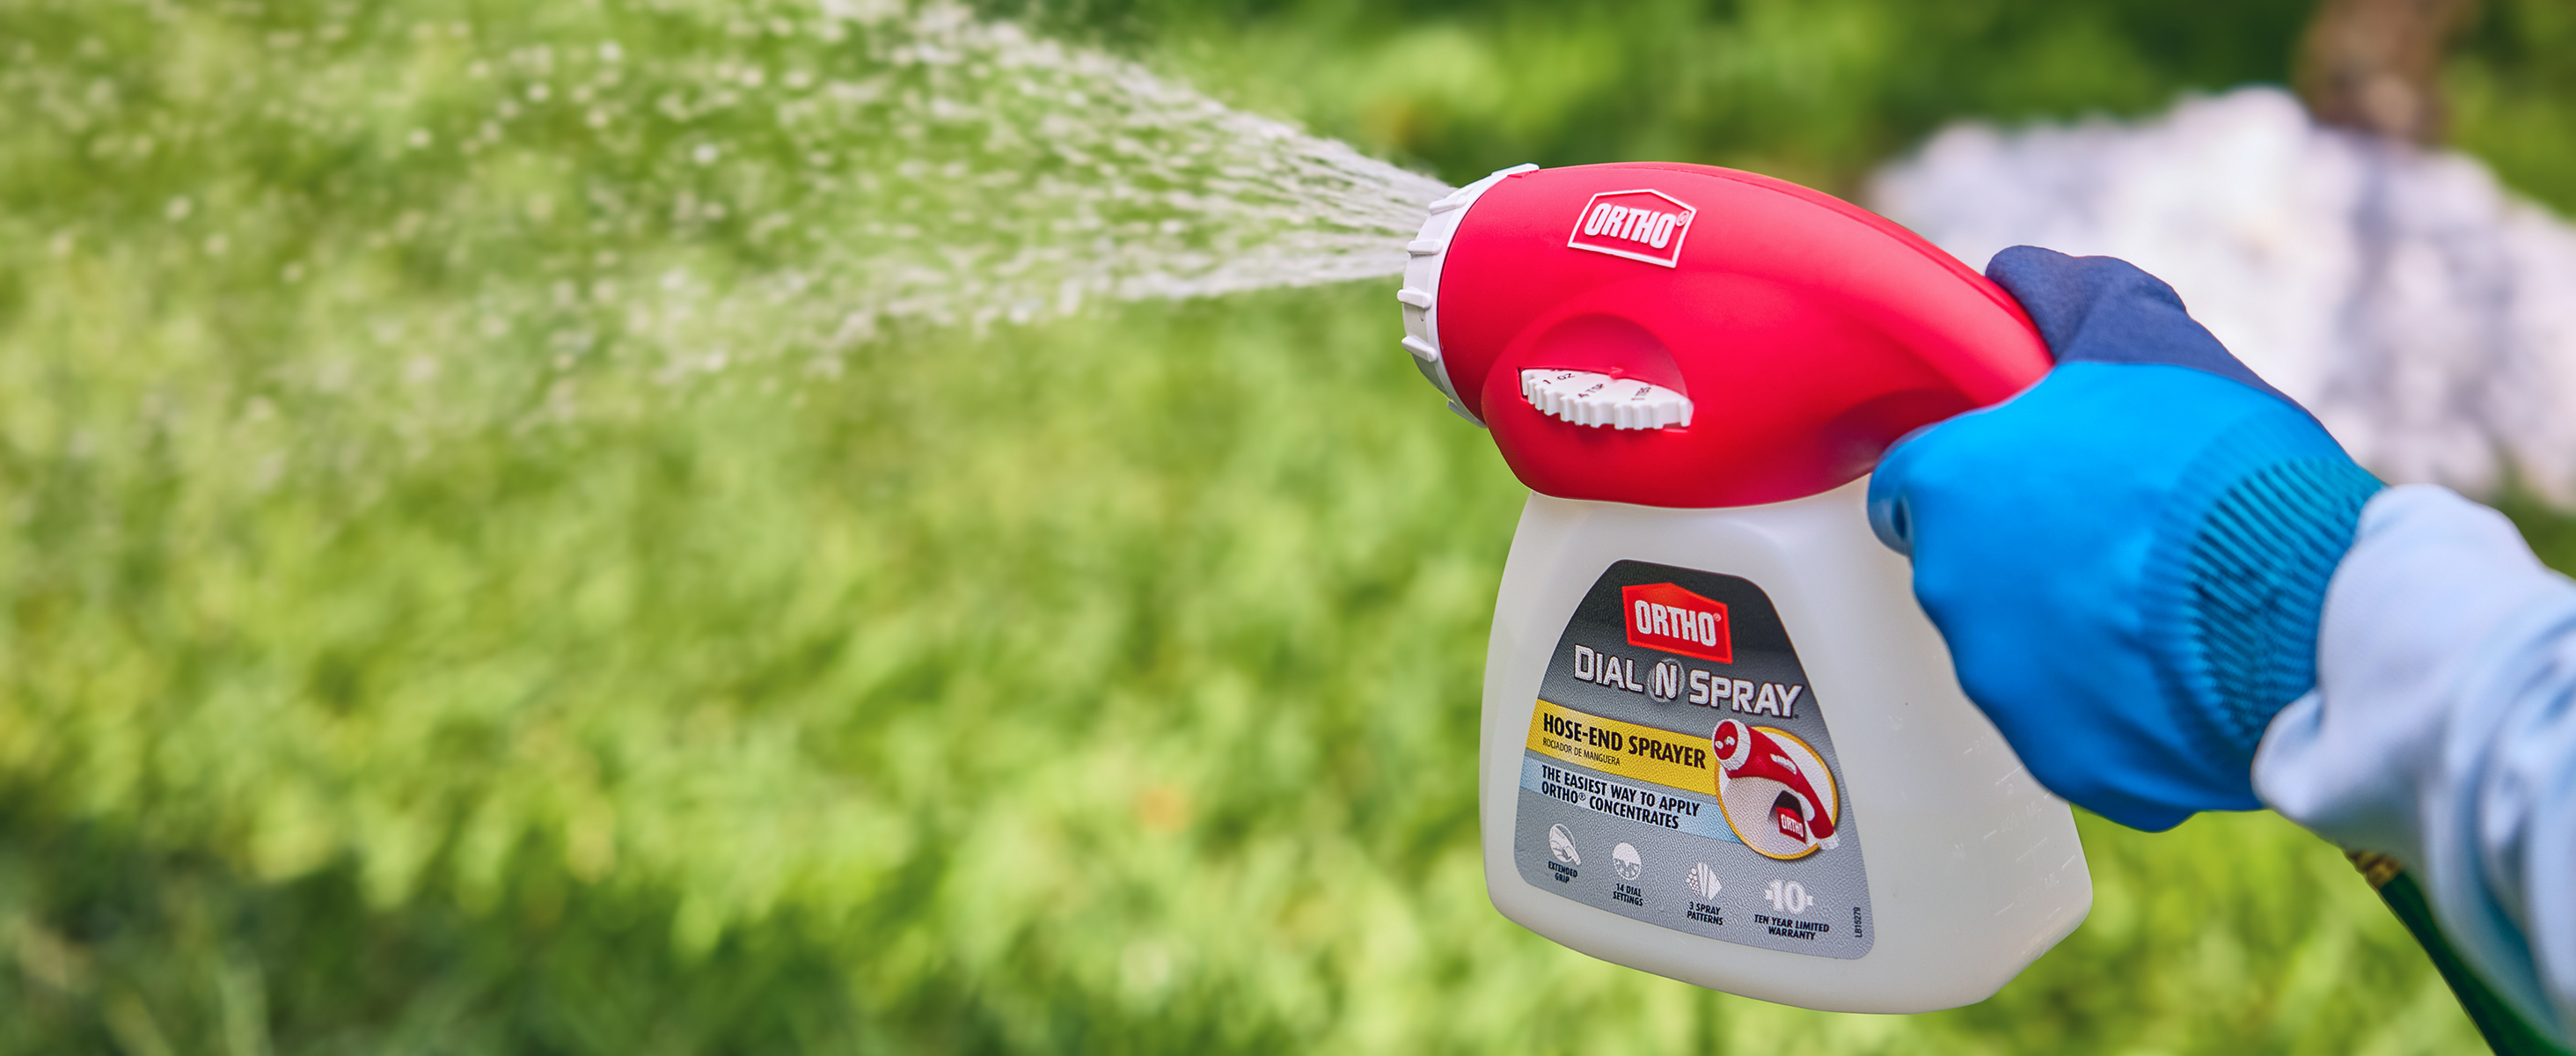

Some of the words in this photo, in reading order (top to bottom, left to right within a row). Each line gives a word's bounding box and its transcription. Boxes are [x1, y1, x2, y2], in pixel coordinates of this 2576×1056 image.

[1573, 644, 1643, 693] DIAL
[1654, 660, 1678, 699] N
[1689, 669, 1804, 718] SPRAY
[1543, 713, 1623, 752] HOSE-END
[1628, 736, 1706, 770] SPRAYER
[1542, 737, 1572, 754] ROCIADOR
[1574, 745, 1583, 756] DE
[1584, 750, 1621, 766] MANGUERA
[1542, 765, 1561, 783] THE
[1564, 772, 1607, 796] EASIEST
[1611, 785, 1637, 803] WAY
[1641, 791, 1656, 808] TO
[1659, 796, 1700, 818] APPLY
[1589, 796, 1679, 830] CONCENTRATES
[1548, 861, 1578, 878] EXTENDED
[1555, 872, 1570, 884] GRIP
[1613, 891, 1643, 906] SETTINGS
[1616, 883, 1624, 892] 14
[1626, 884, 1642, 897] DIAL
[1687, 911, 1723, 925] PATTERNS
[1696, 903, 1721, 915] SPRAY
[1754, 914, 1769, 924] TEN
[1771, 916, 1794, 928] YEAR
[1796, 919, 1830, 933] LIMITED
[1853, 906, 1863, 938] LB15279
[1768, 926, 1816, 941] WARRANTY
